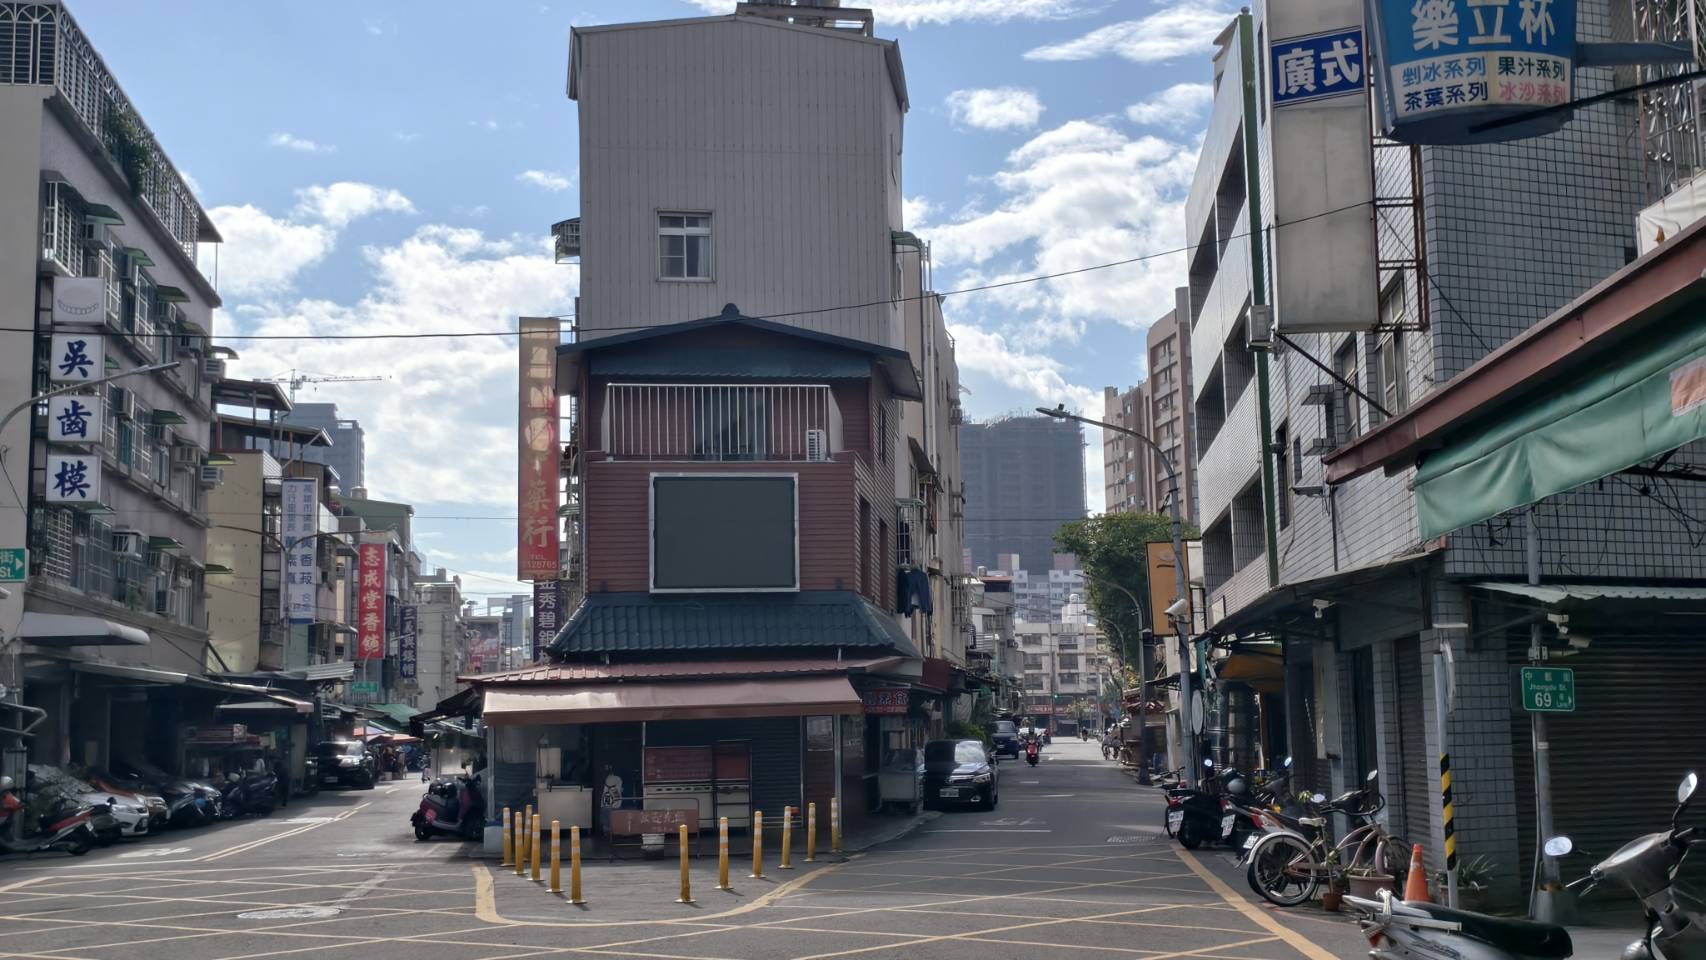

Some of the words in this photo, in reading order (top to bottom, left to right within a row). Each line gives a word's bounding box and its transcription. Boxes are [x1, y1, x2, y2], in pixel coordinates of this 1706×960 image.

[1411, 0, 1555, 51] 樂立杯
[1278, 38, 1360, 95] 廣式
[1498, 56, 1566, 82] 果汁系列
[1404, 82, 1489, 112] 茶葉系列
[1499, 82, 1566, 103] 冰沙系列
[53, 339, 94, 498] 吳齒模
[1535, 692, 1552, 707] 69
